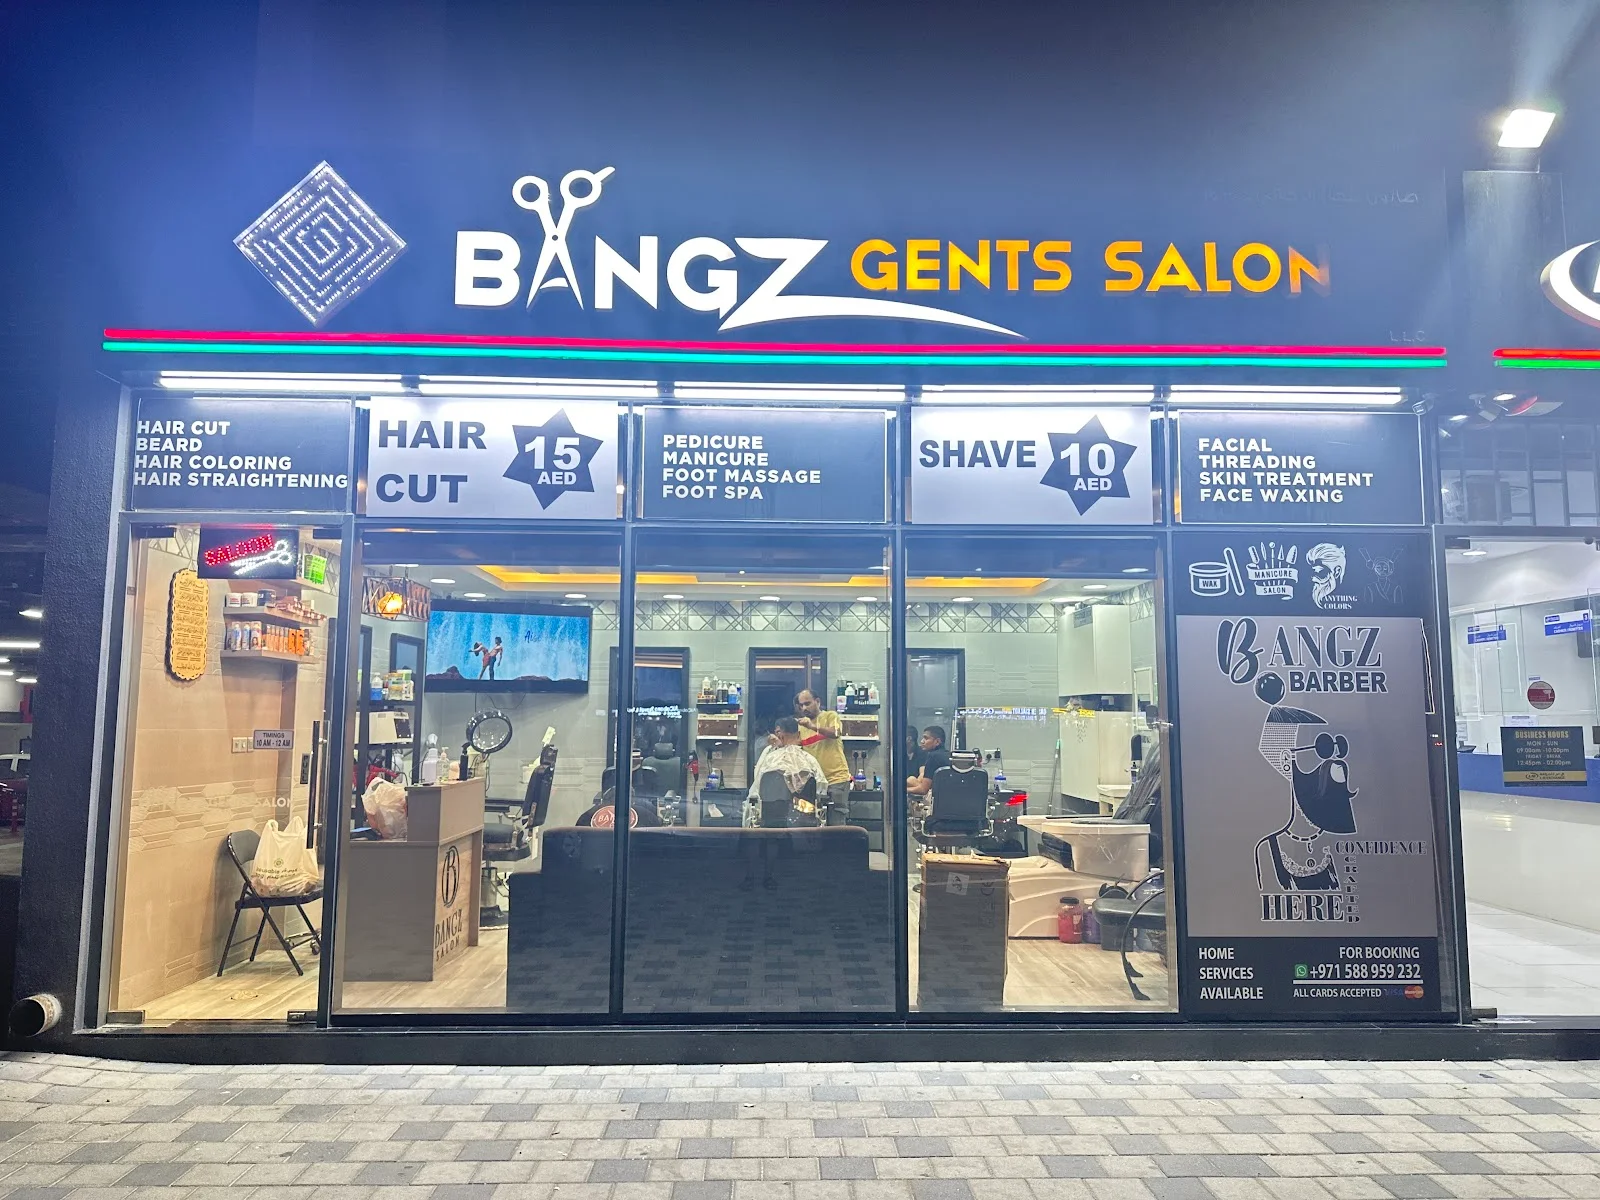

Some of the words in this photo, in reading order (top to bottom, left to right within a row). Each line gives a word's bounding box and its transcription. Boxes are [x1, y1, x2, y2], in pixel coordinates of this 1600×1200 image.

[455, 166, 830, 333] BANGZ
[851, 239, 1073, 291] GENTS
[1105, 241, 1330, 292] SALON
[137, 420, 184, 435] HAIR
[191, 421, 230, 435] CUT
[379, 420, 488, 450] HAIR
[136, 437, 202, 452] BEARD
[663, 434, 763, 450] PEDICURE
[1199, 438, 1272, 452] FACIAL
[524, 437, 581, 467] 15
[663, 451, 768, 467] MANICURE
[919, 440, 1037, 469] SHAVE
[1060, 443, 1116, 476] 10
[135, 454, 182, 469] HAIR
[189, 455, 292, 471] COLORING
[1199, 455, 1316, 470] THREADING
[134, 472, 181, 487] HAIR
[187, 472, 348, 489] STRAIGHTENING
[537, 472, 577, 485] AED
[663, 467, 717, 483] FOOT
[725, 468, 821, 484] MASSAGE
[1073, 476, 1113, 491] AED
[1199, 471, 1246, 486] SKIN
[1253, 472, 1374, 487] TREATMENT
[376, 474, 468, 504] CUT
[662, 484, 717, 499] FOOT
[724, 485, 764, 500] SPA
[1200, 488, 1253, 502] FACE
[1260, 488, 1344, 503] WAXING
[204, 533, 274, 567] SALOON
[1254, 570, 1293, 579] MANICURE
[1202, 580, 1218, 588] WAX
[1216, 617, 1383, 685] BANGZ
[1289, 671, 1388, 693] BARBER
[1515, 731, 1546, 739] BUSINESS
[1335, 841, 1427, 855] CONFIDENCE
[1260, 893, 1345, 921] HERE
[435, 909, 462, 949] BANGZ
[436, 935, 460, 962] SALON
[1199, 947, 1235, 960] HOME
[1339, 947, 1363, 959] FOR
[1365, 946, 1420, 959] BOOKING
[1199, 966, 1254, 980] SERVICES
[1309, 963, 1341, 979] +971
[1344, 963, 1369, 979] 588
[1371, 963, 1395, 979] 959
[1397, 963, 1421, 979] 232
[1199, 987, 1264, 1000] AVAILABLE
[1293, 988, 1309, 998] ALL
[1309, 988, 1339, 998] CARDS
[1339, 988, 1382, 998] ACCEPTED
